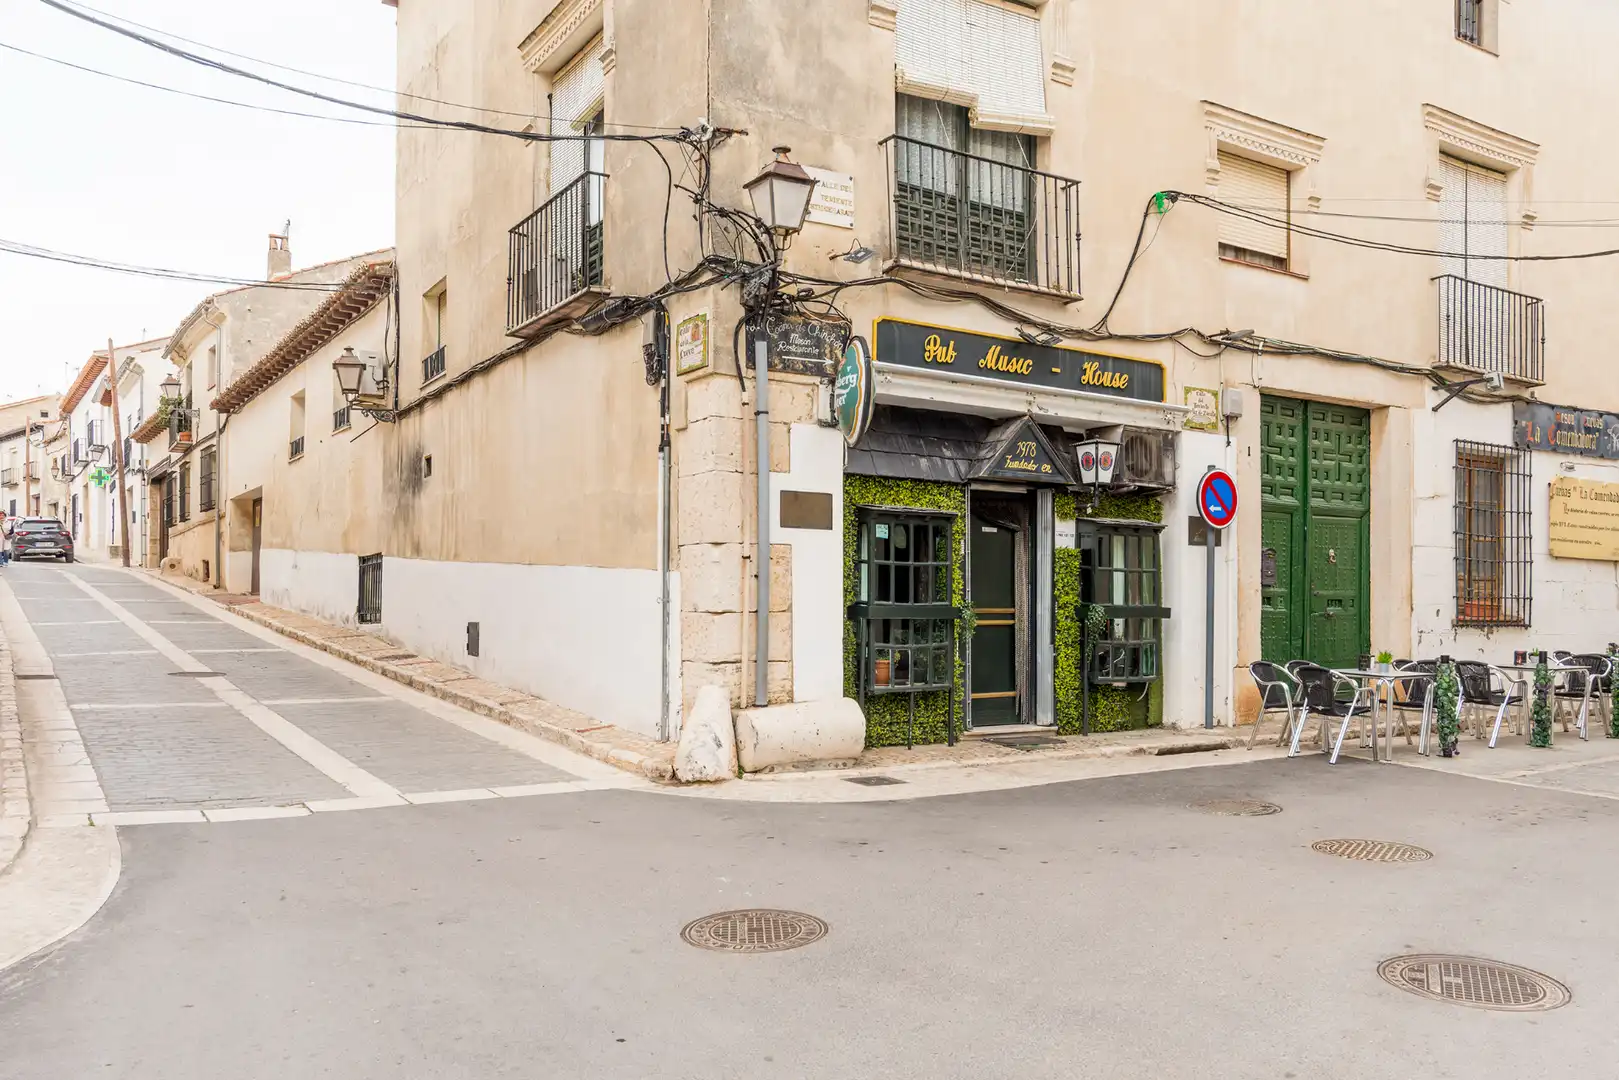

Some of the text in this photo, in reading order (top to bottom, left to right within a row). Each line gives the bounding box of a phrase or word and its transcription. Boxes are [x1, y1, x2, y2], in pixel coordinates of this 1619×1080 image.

[777, 341, 819, 355] Restaurante
[924, 334, 957, 363] Pub
[978, 344, 1033, 376] Music
[1080, 361, 1129, 389] House
[1015, 441, 1037, 458] 1978
[1041, 463, 1053, 473] en
